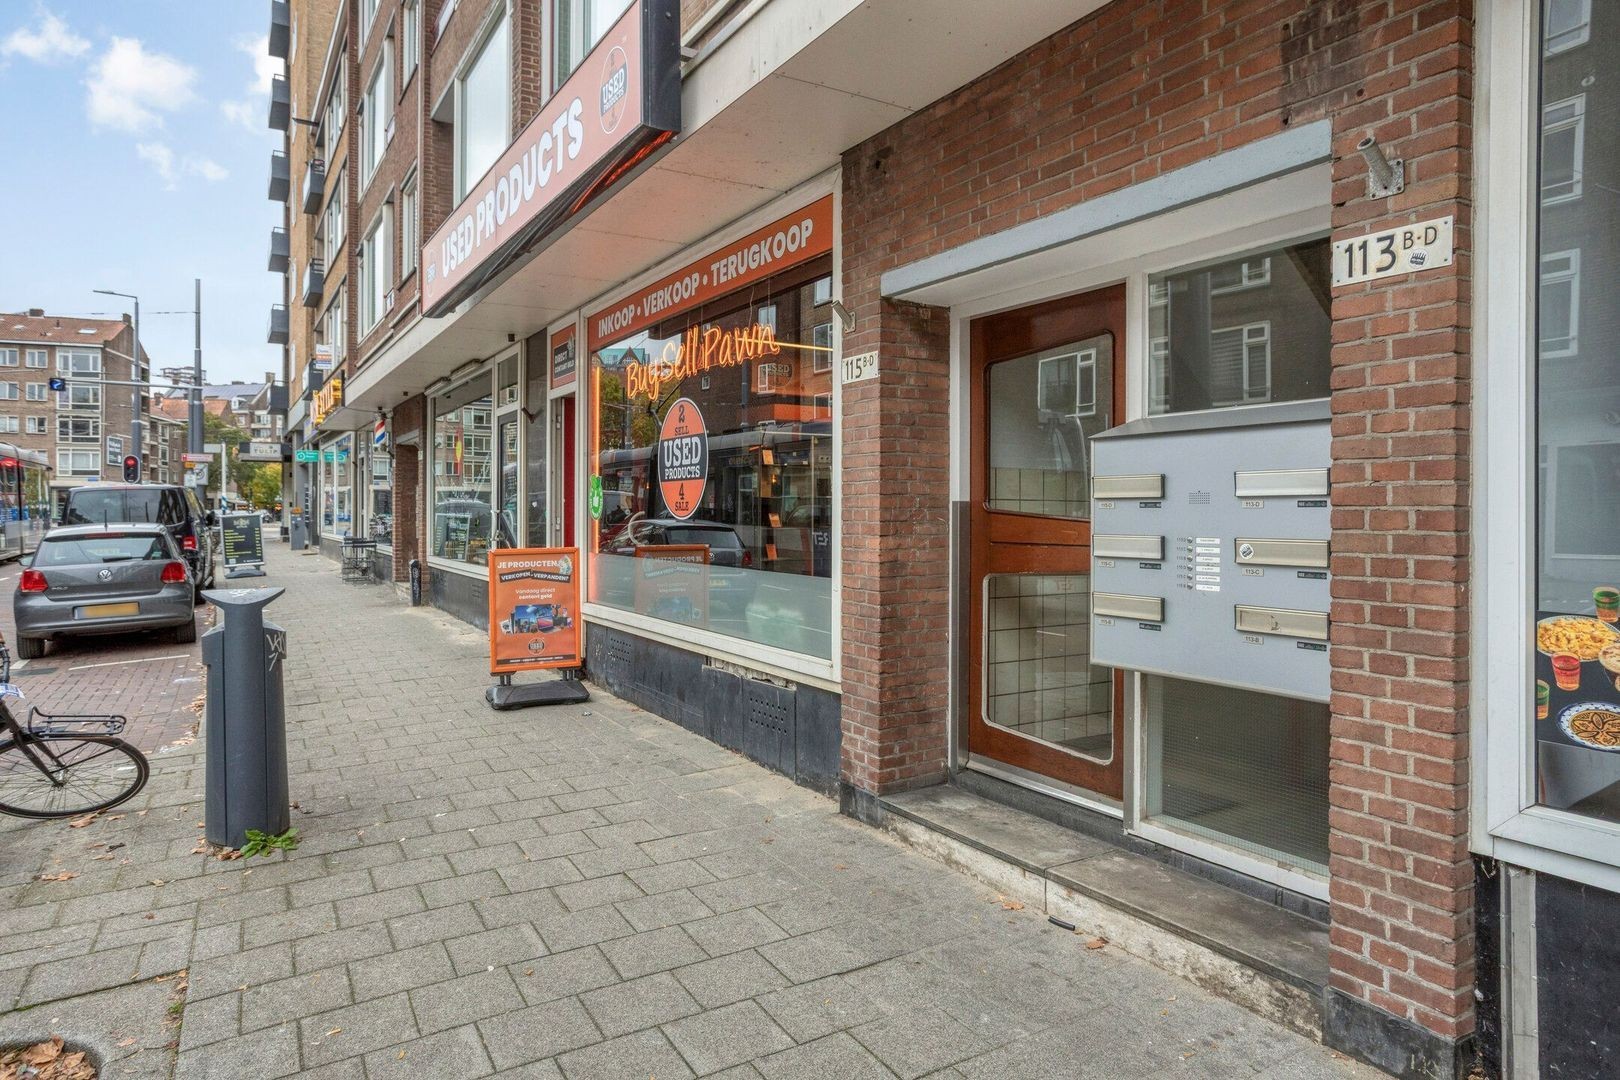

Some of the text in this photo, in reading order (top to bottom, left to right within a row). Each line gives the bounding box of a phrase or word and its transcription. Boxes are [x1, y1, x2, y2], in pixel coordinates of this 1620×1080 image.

[602, 67, 625, 104] USED
[442, 97, 583, 278] USED PRODUCTS
[1344, 234, 1397, 278] 113
[598, 218, 813, 338] INKOOP VERKOOP TERUGKOOP
[626, 322, 781, 402] Buy Sell Pawn
[845, 357, 862, 380] 115
[678, 404, 686, 424] 2
[674, 425, 689, 436] SELL
[663, 436, 701, 468] USED
[664, 466, 701, 480] PRODUCTS
[678, 482, 685, 500] 4
[674, 501, 689, 511] SALE
[497, 560, 558, 569] JE PRODUCTEN
[500, 571, 531, 581] VERKOPEN
